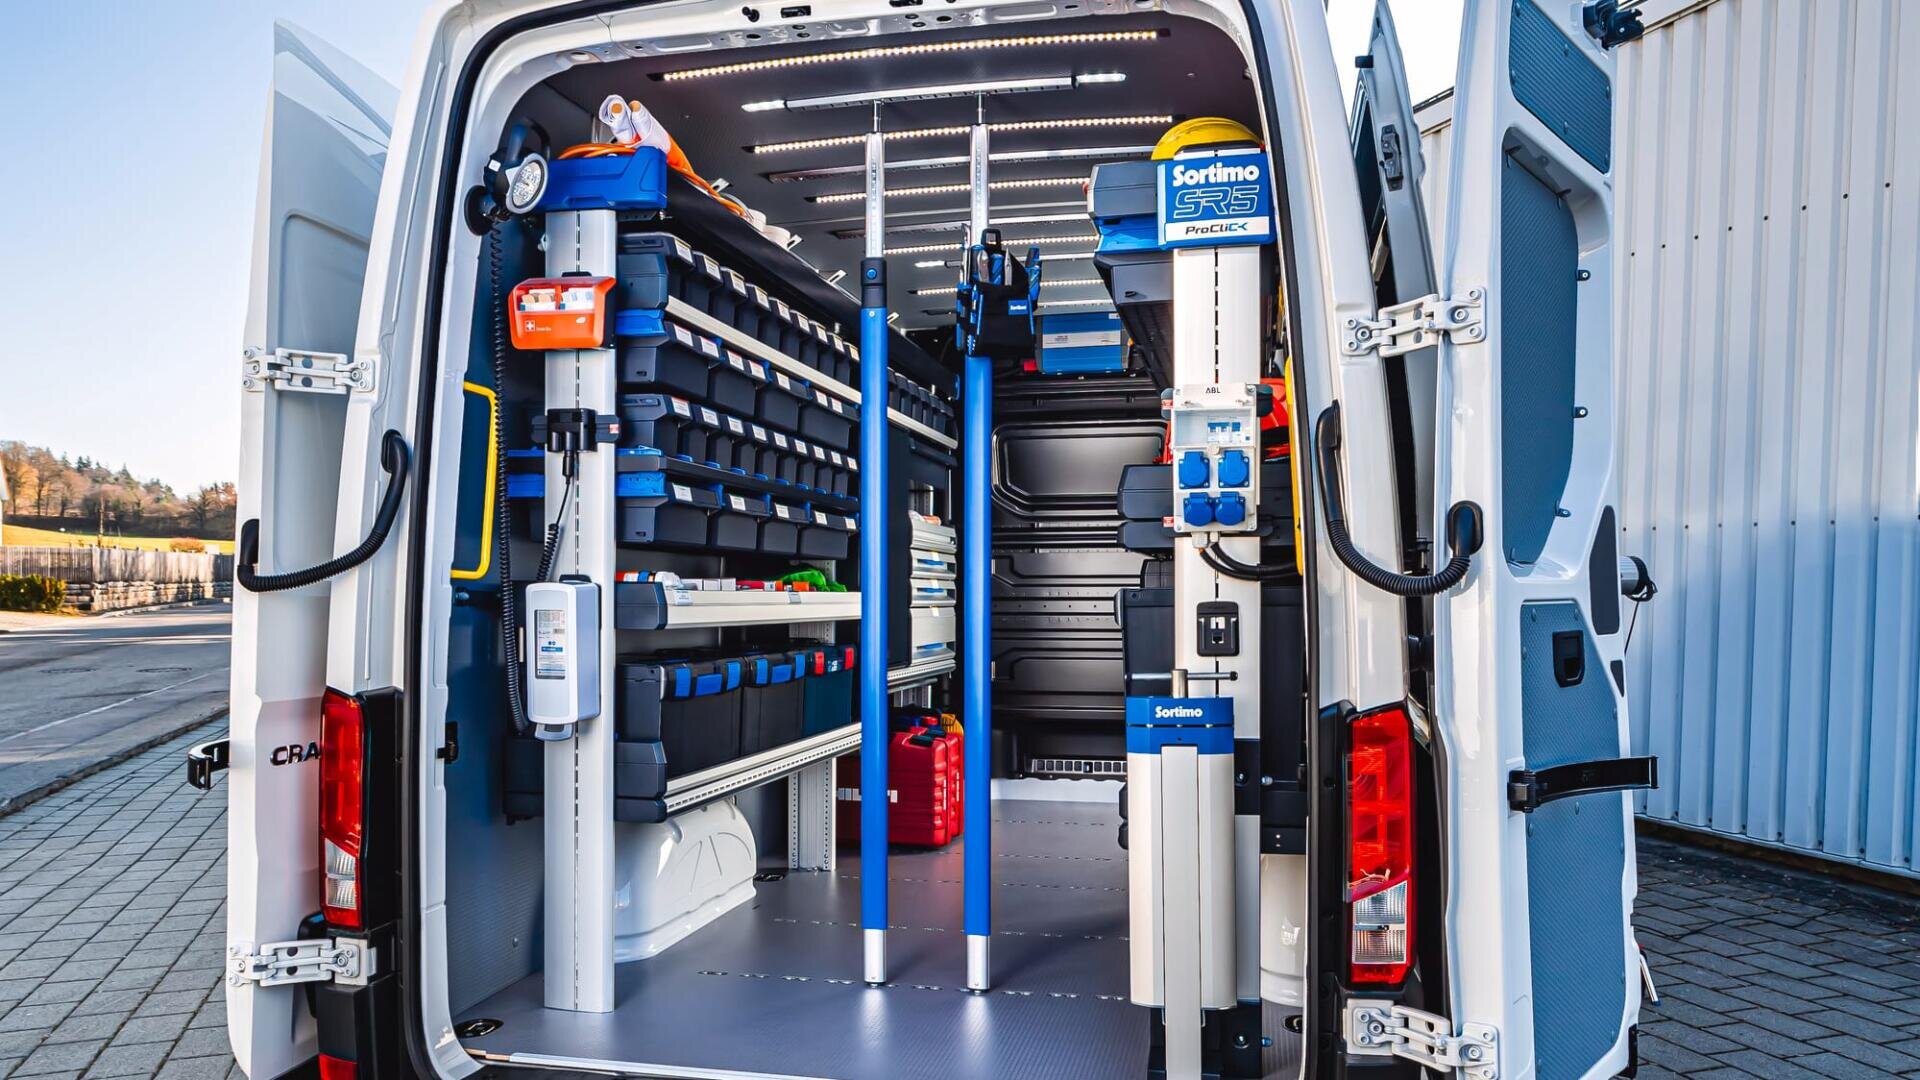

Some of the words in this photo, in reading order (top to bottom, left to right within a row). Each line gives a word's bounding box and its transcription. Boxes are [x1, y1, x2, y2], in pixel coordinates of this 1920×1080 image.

[1173, 162, 1259, 187] Sortimo
[1174, 185, 1259, 218] SR5
[1155, 705, 1203, 718] Sortimo
